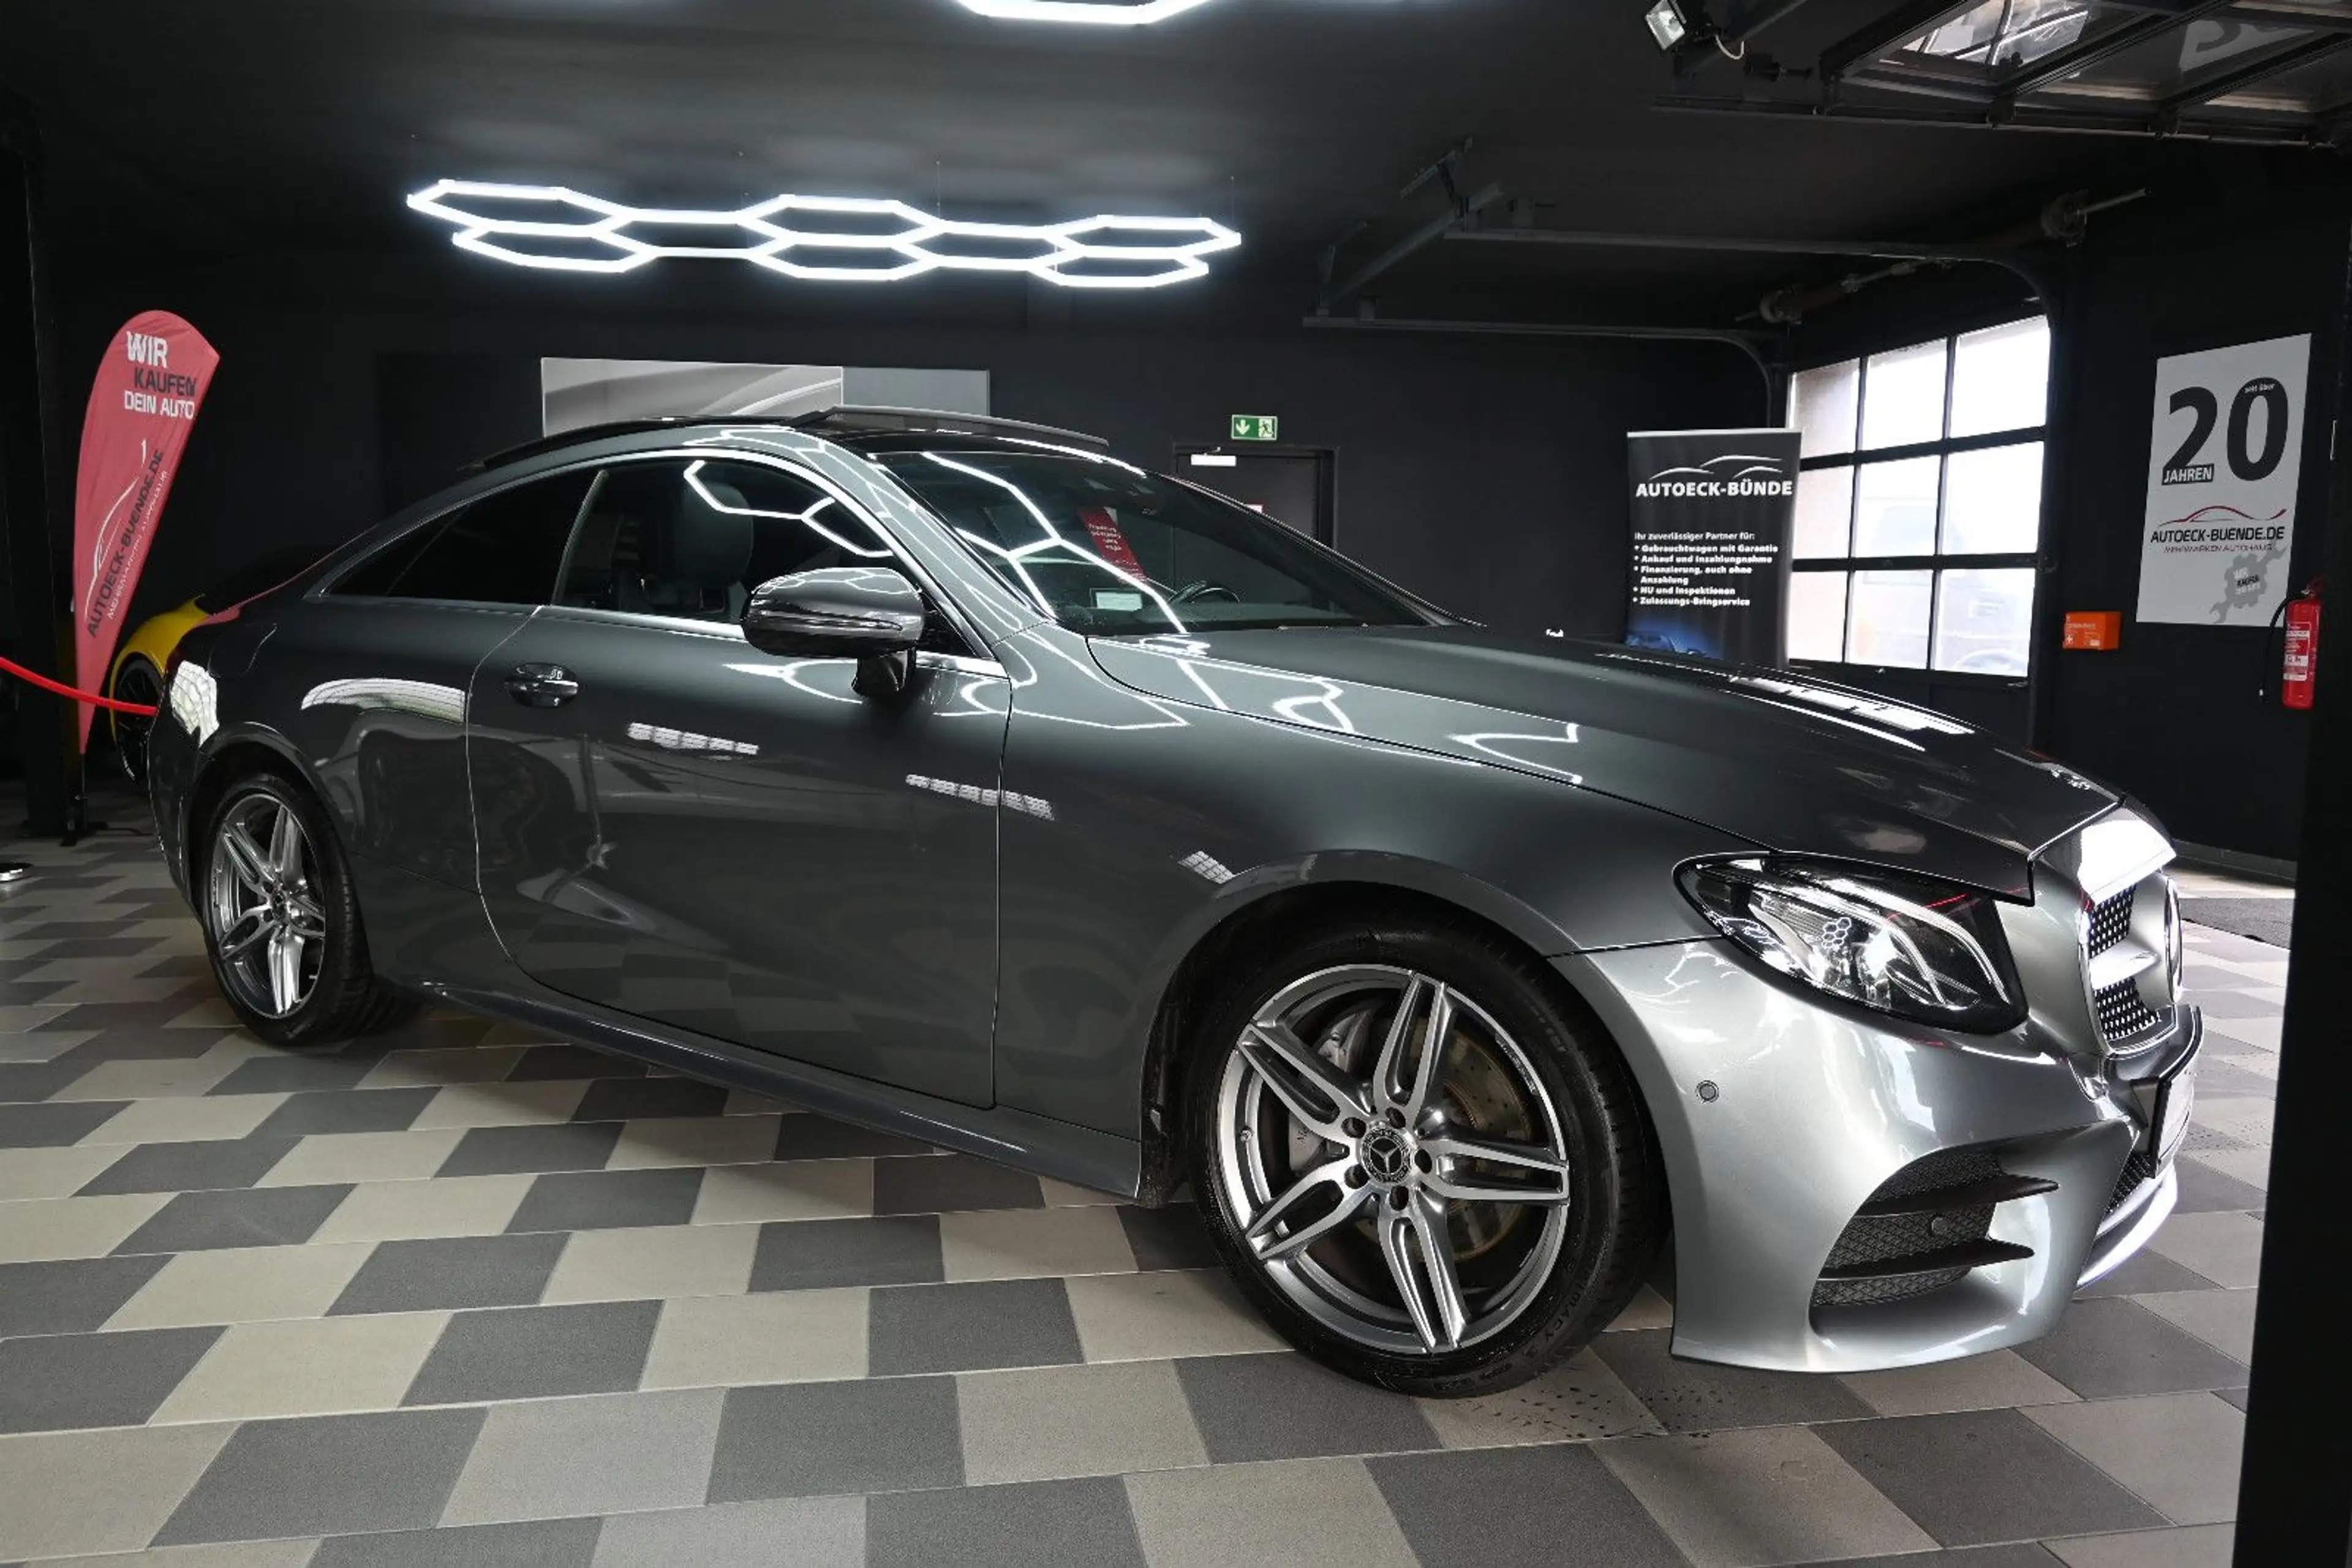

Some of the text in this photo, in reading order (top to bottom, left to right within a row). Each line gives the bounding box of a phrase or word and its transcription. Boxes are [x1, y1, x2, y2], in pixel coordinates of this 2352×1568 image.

[126, 331, 168, 368] WIR
[134, 368, 197, 397] KAUFEN
[124, 390, 195, 420] DEIN AUTO
[2162, 377, 2288, 481] 20
[2164, 467, 2212, 483] JAHREN
[1635, 478, 1793, 497] AUTOECK-BÜNDE
[1635, 532, 1646, 540] Ihr
[1648, 532, 1703, 542] zuverlässiger
[1705, 531, 1738, 540] Partner
[2150, 526, 2285, 543] AUTOECK-BUENDE.DE
[1642, 544, 1717, 554] Gebrauchtwagen
[1719, 544, 1735, 552] mit
[1676, 554, 1694, 563] und
[1705, 565, 1727, 574] auch
[1656, 586, 1673, 595] und
